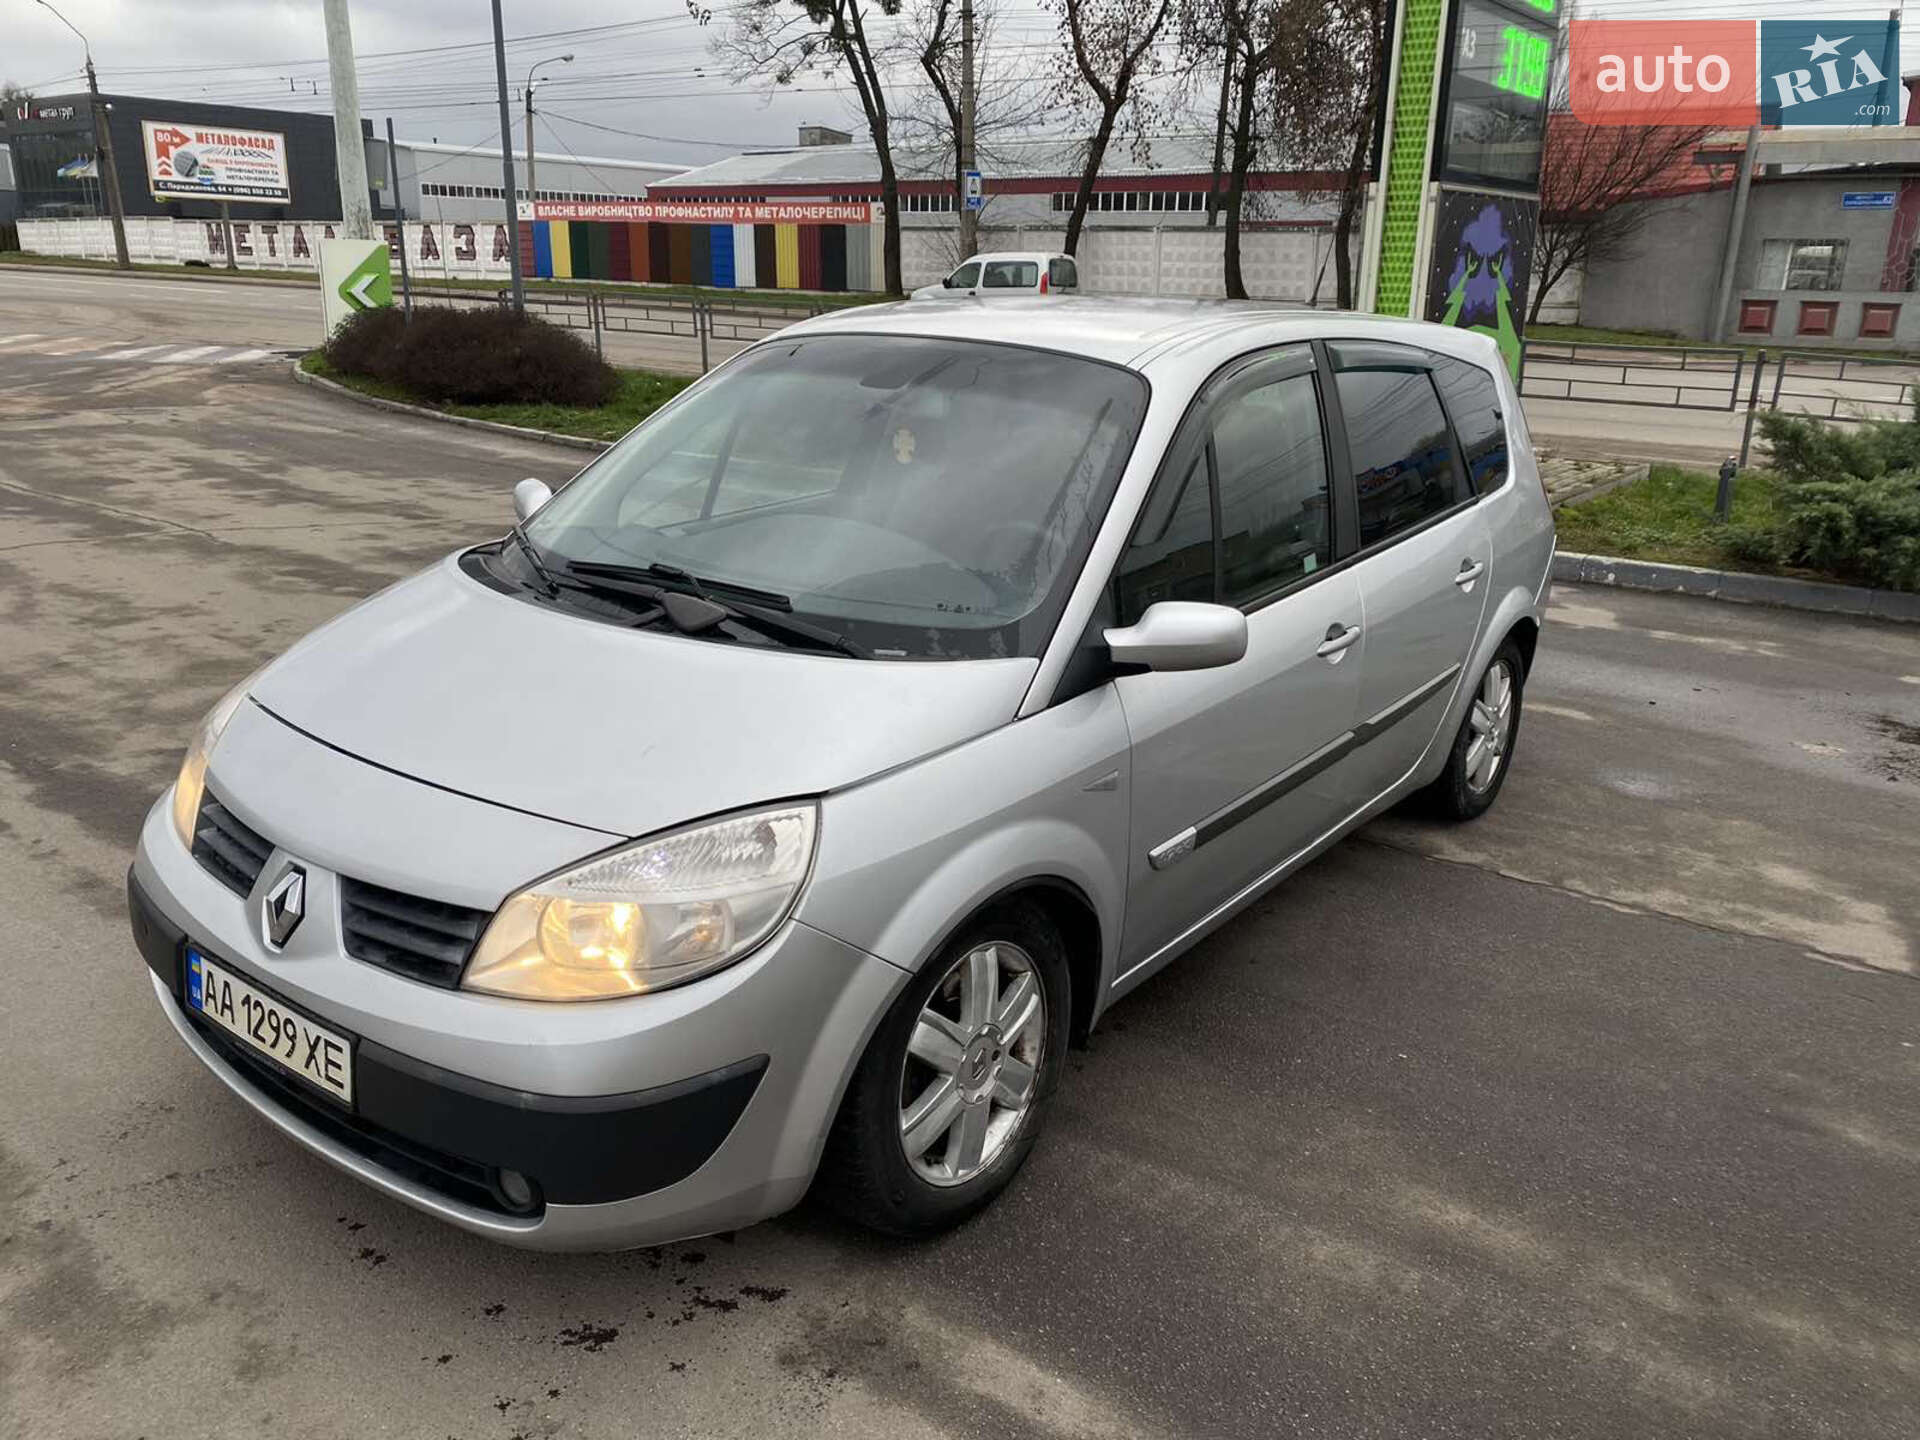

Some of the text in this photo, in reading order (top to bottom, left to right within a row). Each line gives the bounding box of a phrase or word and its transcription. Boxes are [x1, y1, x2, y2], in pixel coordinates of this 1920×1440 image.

[156, 130, 171, 142] 80
[195, 132, 276, 151] МЕТАЛОФАСАД
[538, 205, 865, 220] ВЛАСНЕ ВИРОБНИЦТВО ПРОФНАСТИЛУ ТА МЕТАЛОЧЕРЕПИЦІ
[204, 968, 235, 1025] AA
[241, 993, 297, 1059] 1299
[303, 1026, 344, 1090] XE
